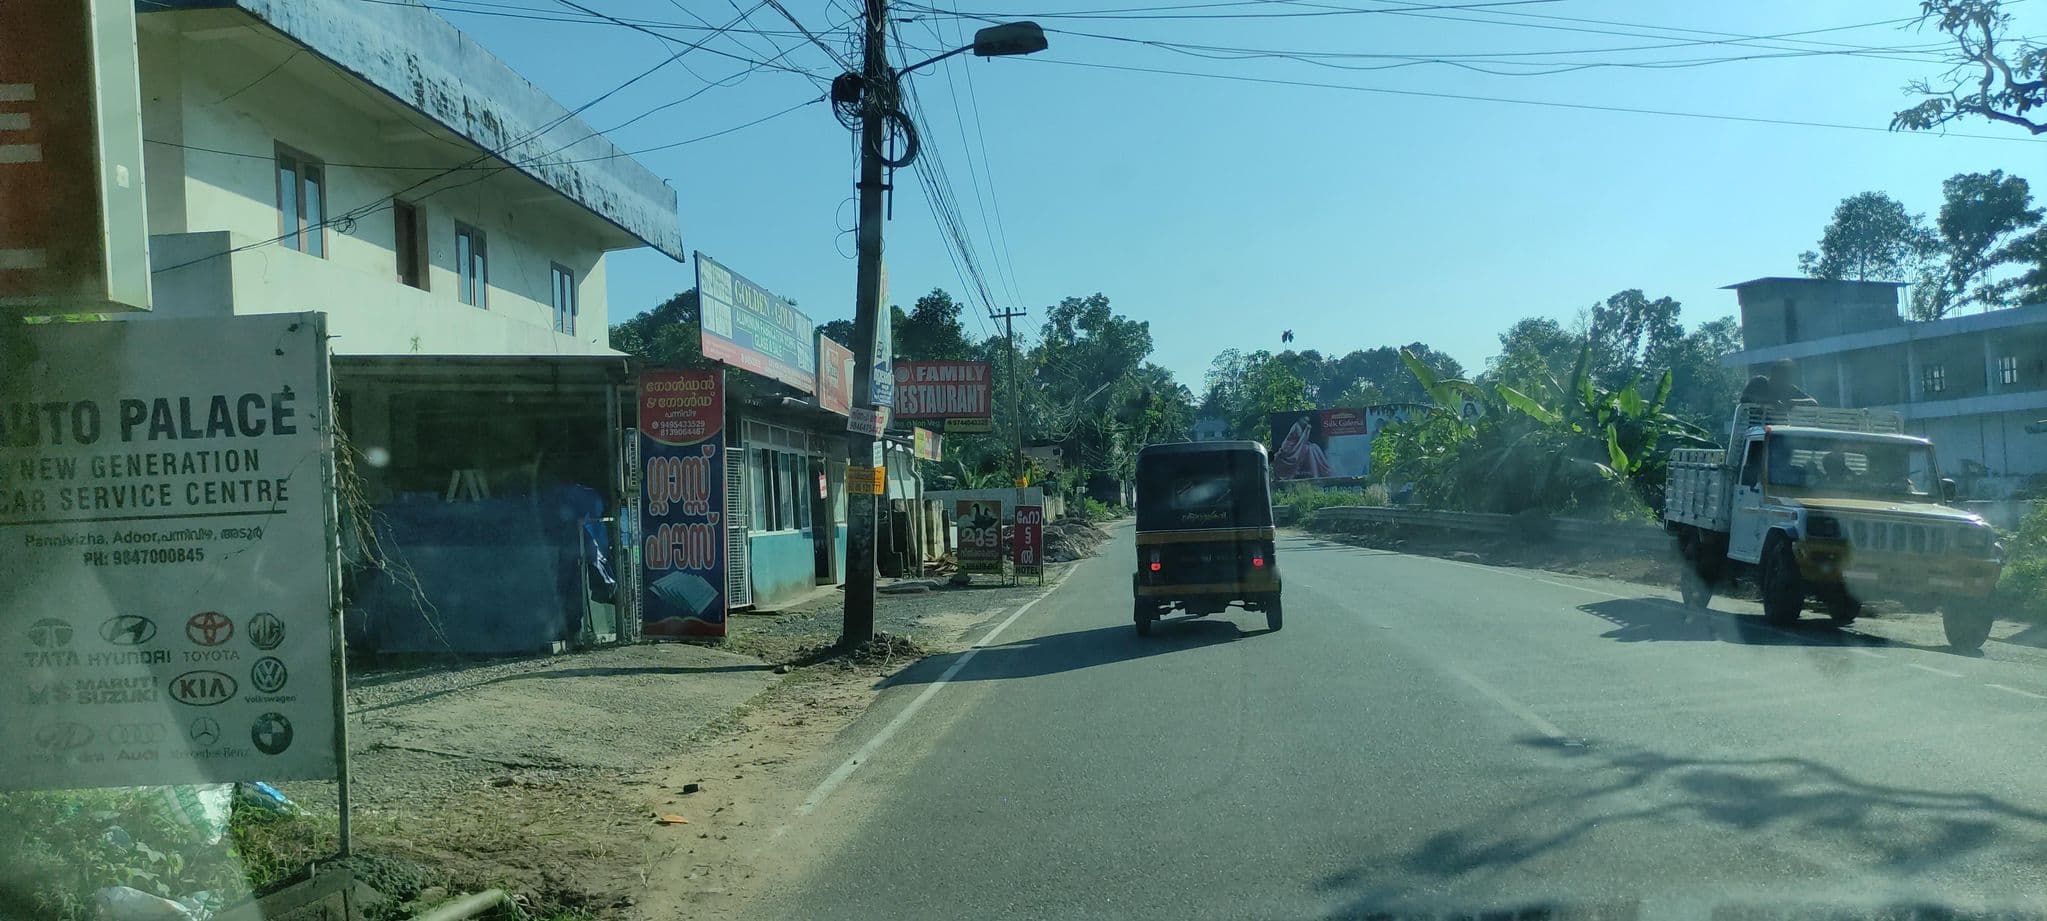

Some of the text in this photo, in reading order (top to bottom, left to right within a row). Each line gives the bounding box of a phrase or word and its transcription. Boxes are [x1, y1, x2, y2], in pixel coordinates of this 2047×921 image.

[734, 279, 770, 317] GOLDEN
[775, 302, 795, 331] GOLD
[916, 365, 986, 382] FAMILY
[646, 375, 715, 394] ഗോൾഡൻ
[120, 392, 298, 442] PALACE
[20, 453, 77, 480] NEW
[91, 448, 260, 479] GENERATION
[61, 483, 173, 512] SERVICE
[186, 478, 289, 506] CENTRE
[645, 512, 720, 570] ഹൗസ്
[83, 547, 205, 567] PH: 9847000845
[1015, 565, 1039, 575] HOTEL
[24, 650, 241, 668] TATA HYUNDAI TOYOTA
[77, 690, 159, 705] SUZUKI
[180, 677, 229, 700] KIA
[245, 693, 297, 706] Volkswagen
[117, 750, 159, 762] Audi
